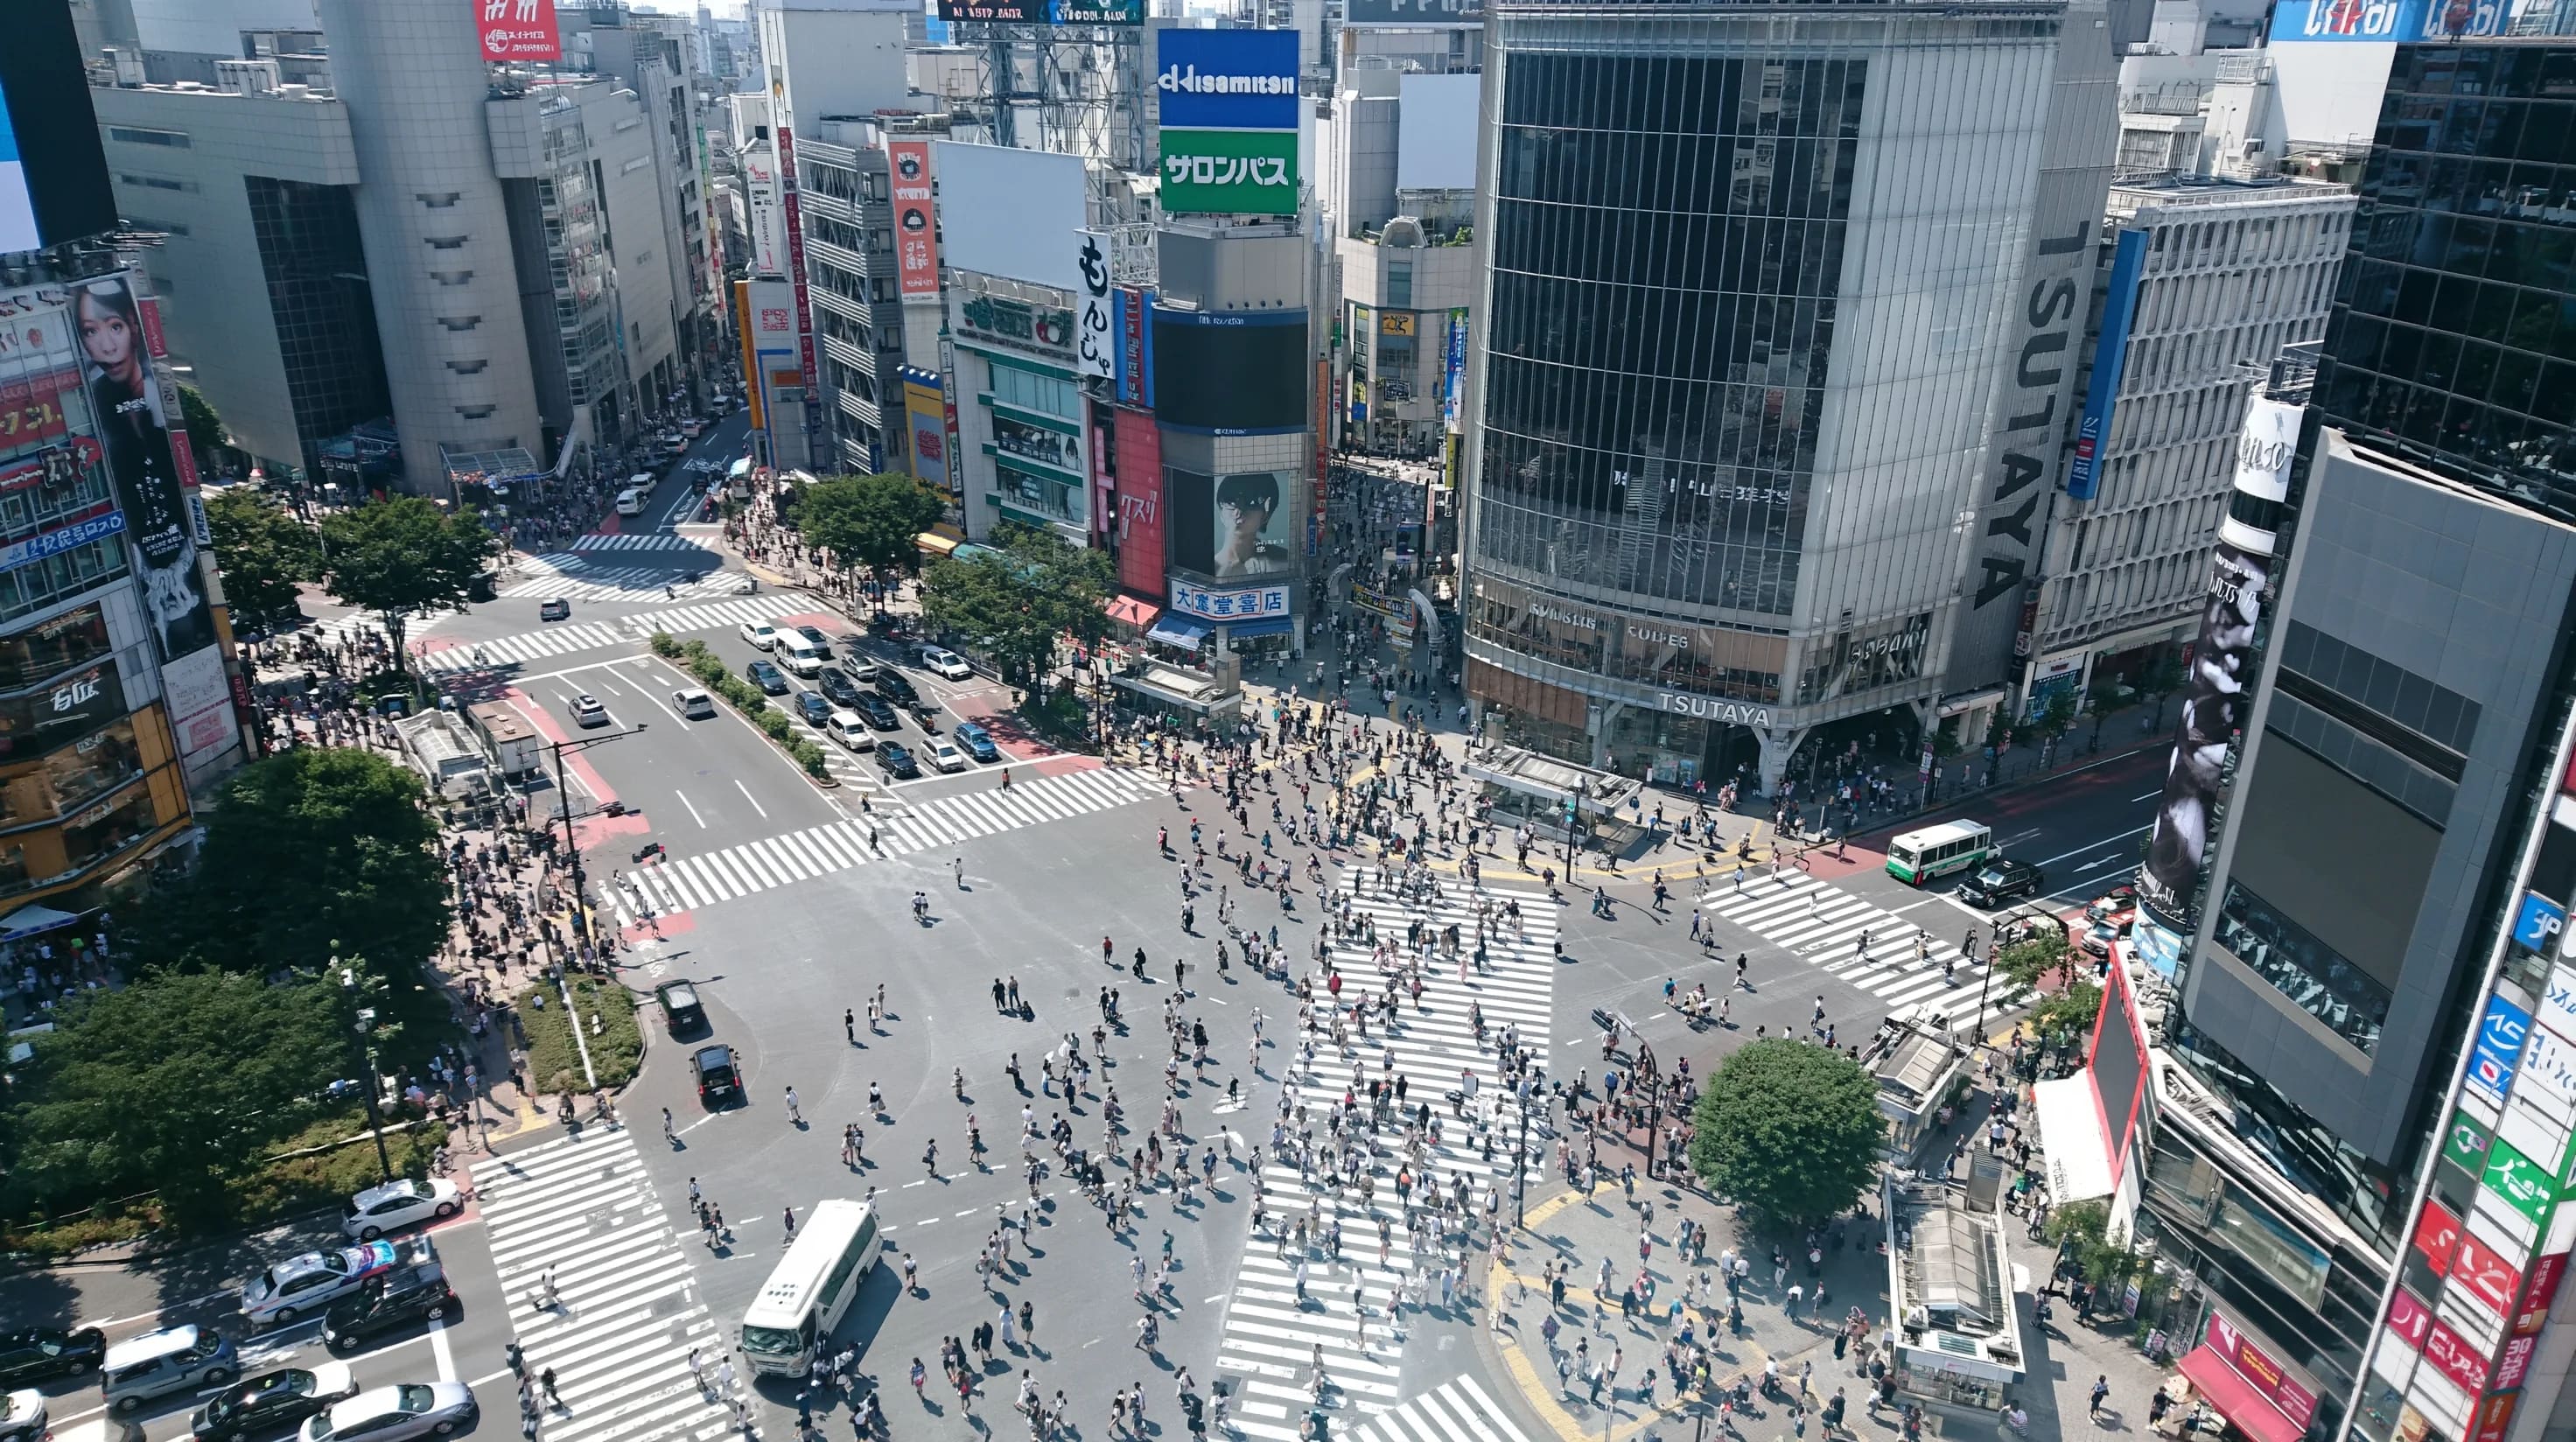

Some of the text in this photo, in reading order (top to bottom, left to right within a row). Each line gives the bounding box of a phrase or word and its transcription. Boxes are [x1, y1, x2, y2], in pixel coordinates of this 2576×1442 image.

[1166, 155, 1289, 186] サロンパス
[1079, 236, 1111, 376] もんじゃ
[1974, 220, 2090, 611] TSUTAYA
[1659, 693, 1770, 727] TSUTAYA
